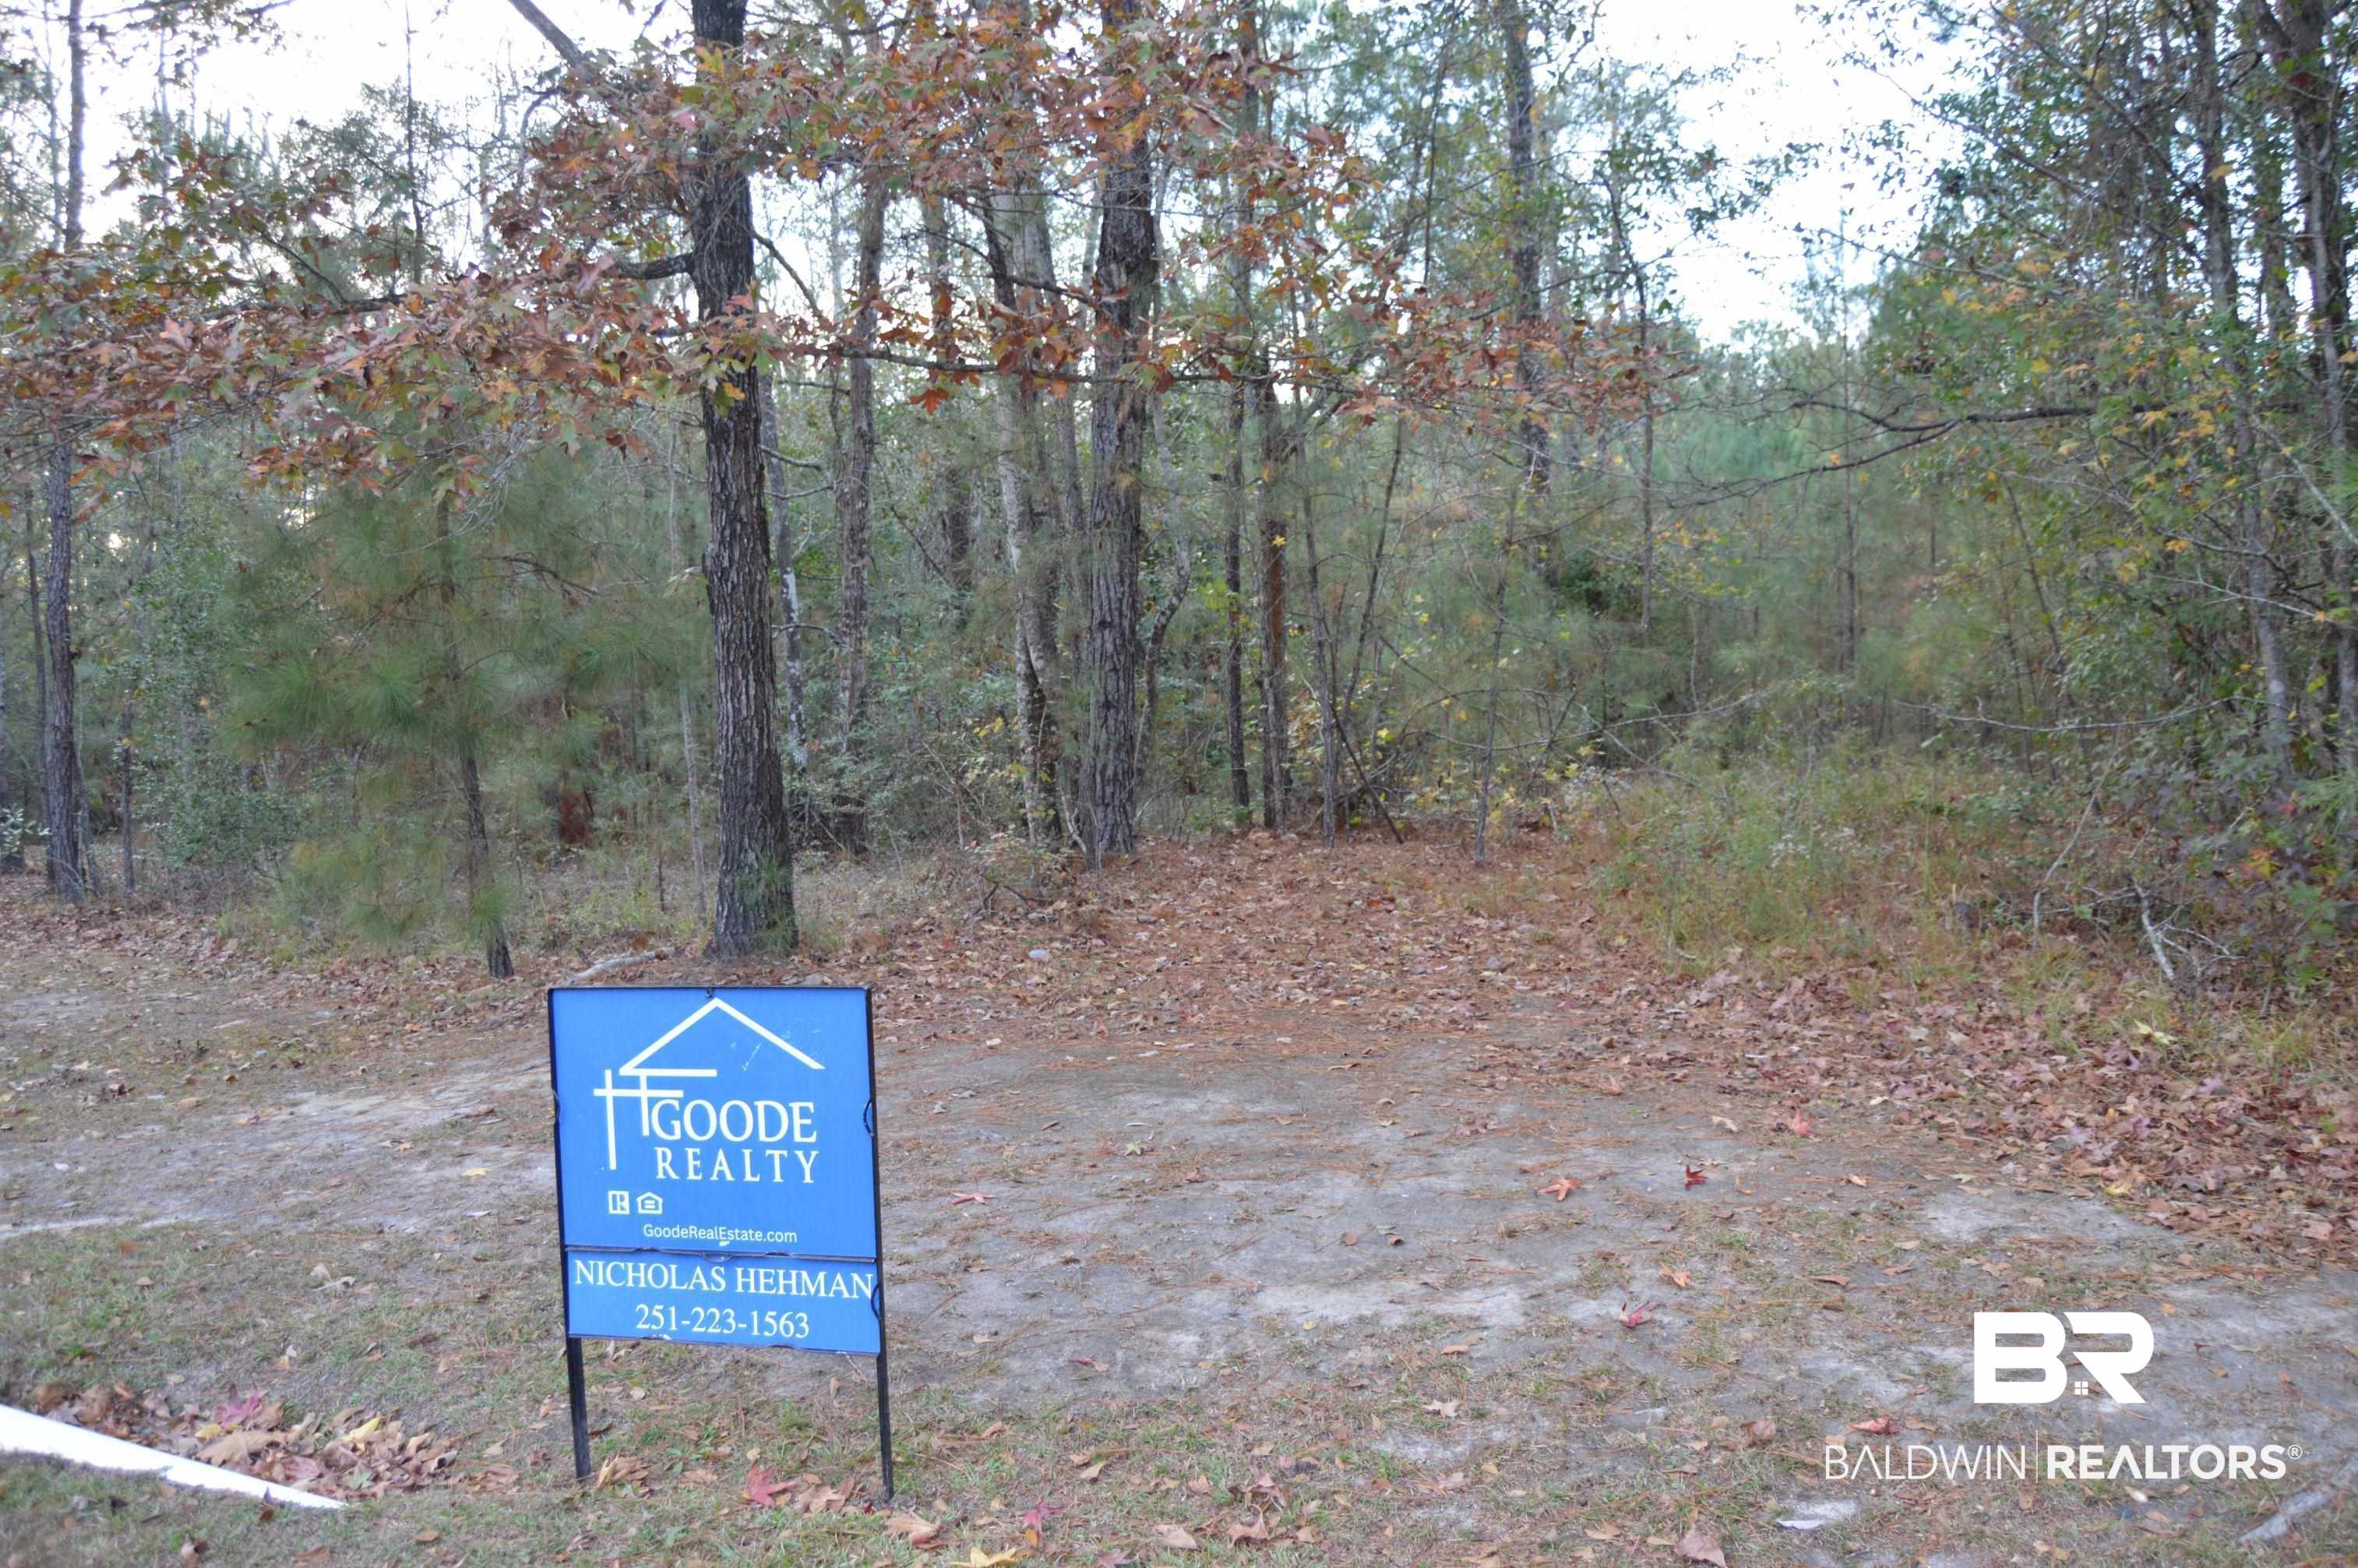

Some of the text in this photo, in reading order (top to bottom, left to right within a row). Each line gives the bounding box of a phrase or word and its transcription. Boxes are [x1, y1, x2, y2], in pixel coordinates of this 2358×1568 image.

[651, 1098, 817, 1143] GOODE
[656, 1147, 819, 1183] REALTY
[643, 1224, 798, 1243] GoodeRealEstate.com
[574, 1260, 872, 1298] NICHOLAS HEHMAN
[636, 1304, 809, 1338] 251-223-1563
